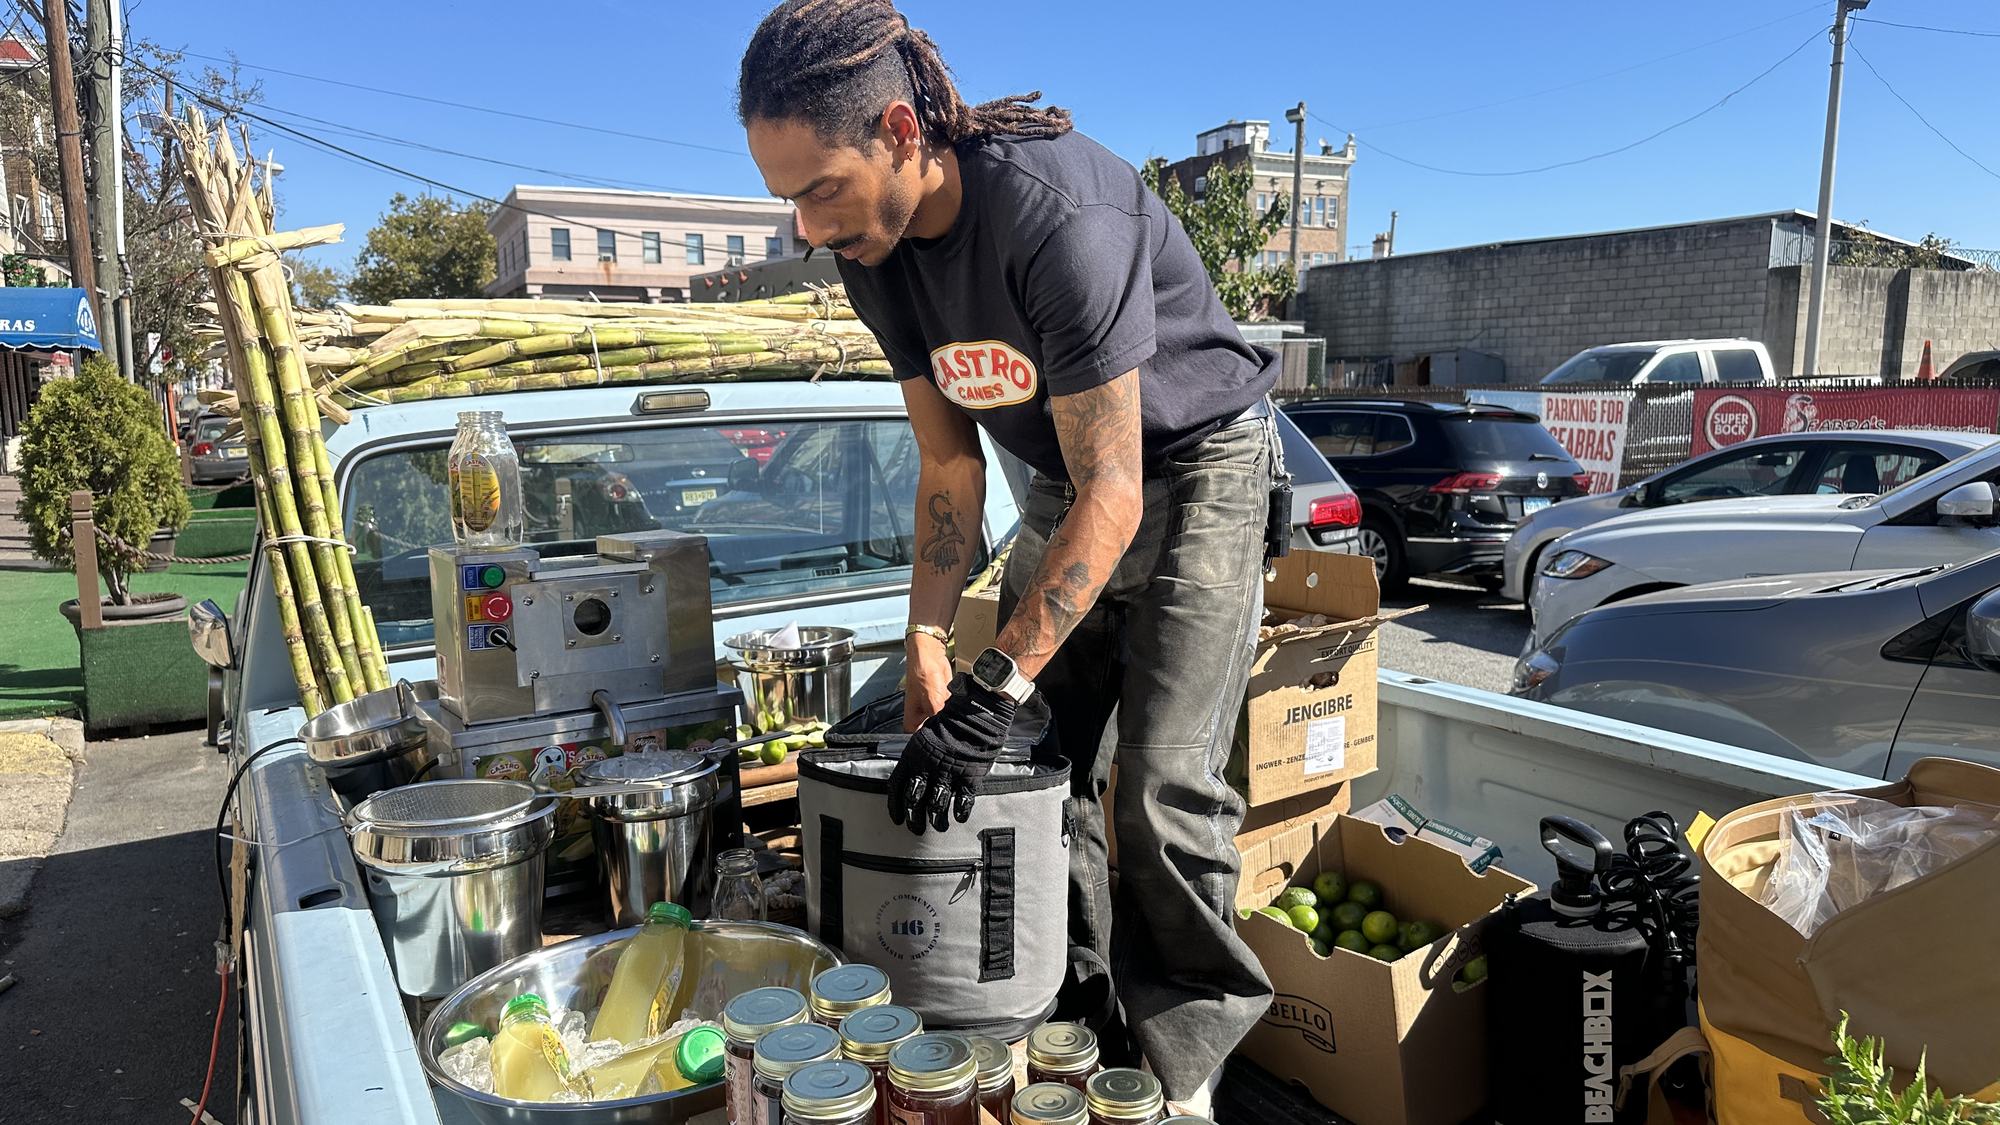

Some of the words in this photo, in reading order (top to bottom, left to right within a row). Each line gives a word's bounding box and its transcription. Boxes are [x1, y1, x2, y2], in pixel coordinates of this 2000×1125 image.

[0, 319, 36, 332] RAS
[933, 348, 1032, 391] CASTRO
[958, 383, 1005, 401] CANES
[1546, 397, 1596, 423] PARKING
[1600, 399, 1624, 424] FOR
[1714, 412, 1749, 425] SUPER
[1714, 424, 1747, 436] BOCK
[1321, 647, 1348, 659] EXPORT
[1348, 641, 1374, 654] QUALITY
[1284, 694, 1353, 726] JENGIBRE
[1256, 759, 1283, 771] INGWER
[1353, 735, 1375, 747] GEMBER
[490, 763, 520, 775] CASTRO
[893, 894, 937, 917] COMMUNITY
[892, 920, 924, 935] 116
[1265, 1002, 1326, 1031] BELLO
[1583, 970, 1613, 1123] BEACHBOX
